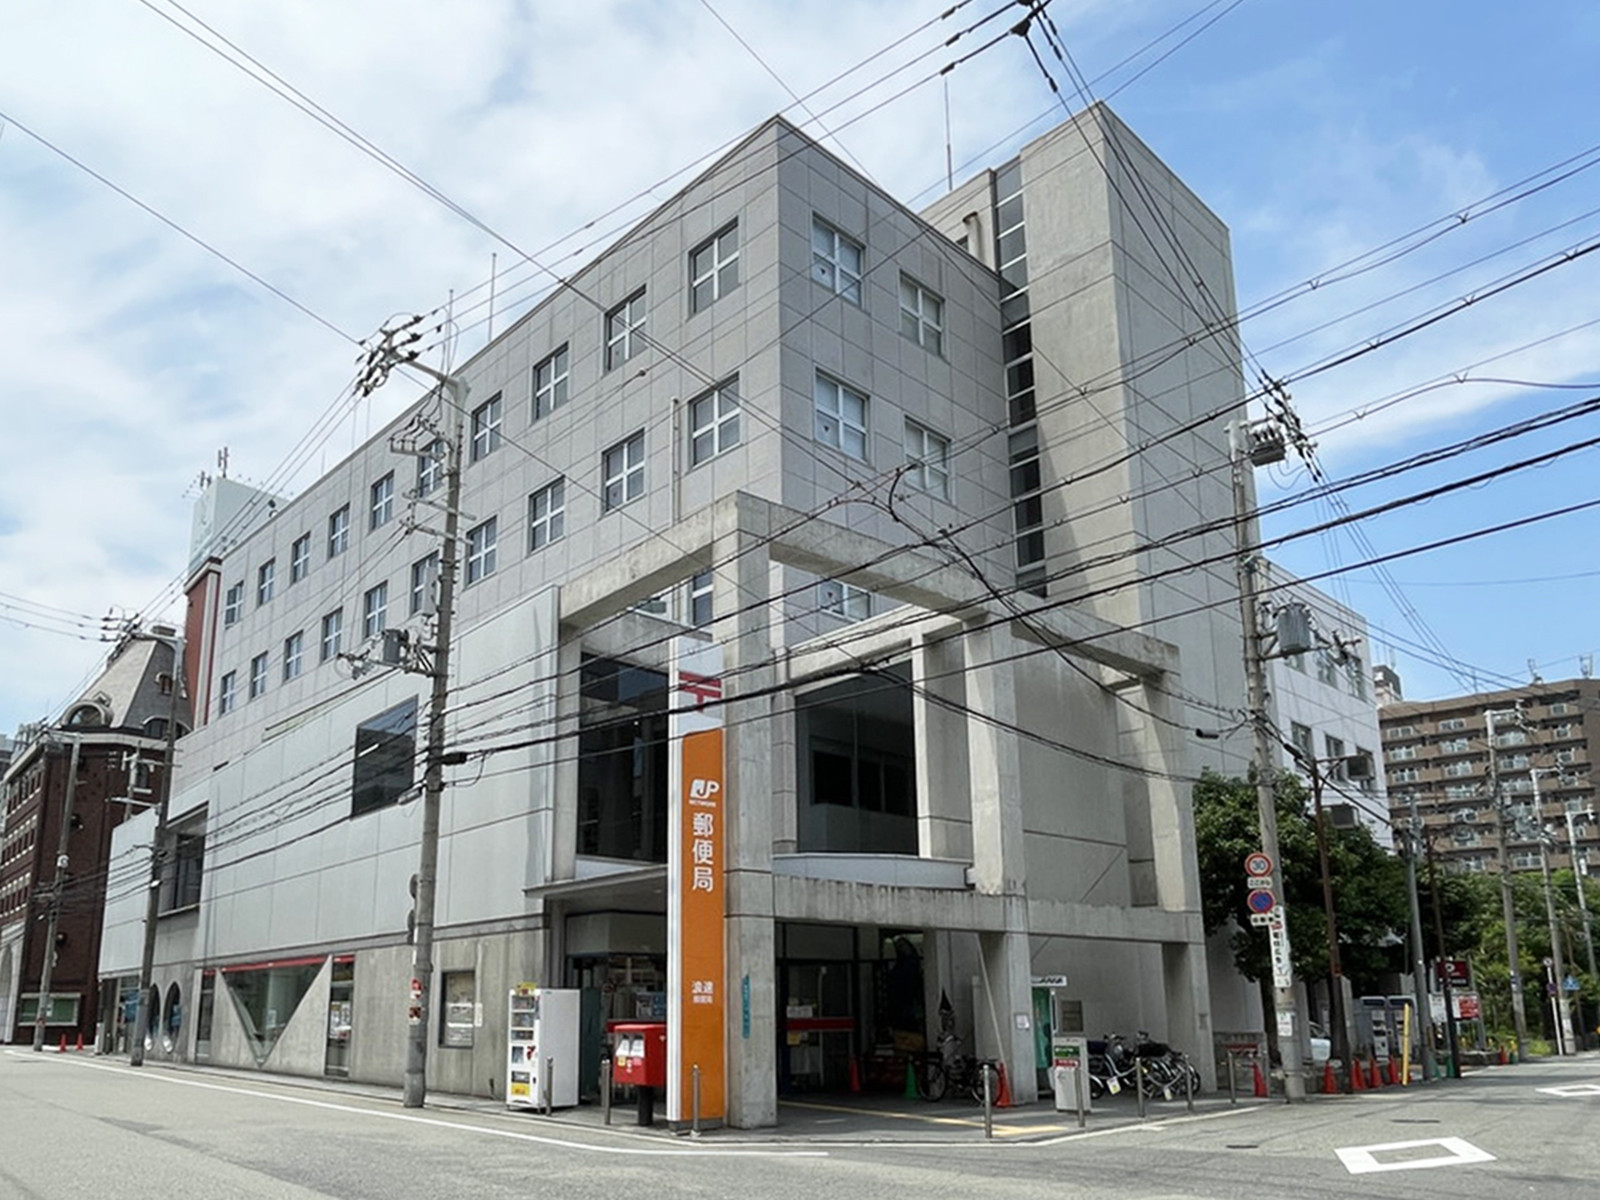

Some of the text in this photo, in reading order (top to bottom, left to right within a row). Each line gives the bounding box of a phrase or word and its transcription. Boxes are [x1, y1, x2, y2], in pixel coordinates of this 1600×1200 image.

[690, 779, 720, 799] JP
[692, 813, 714, 892] 郵便局
